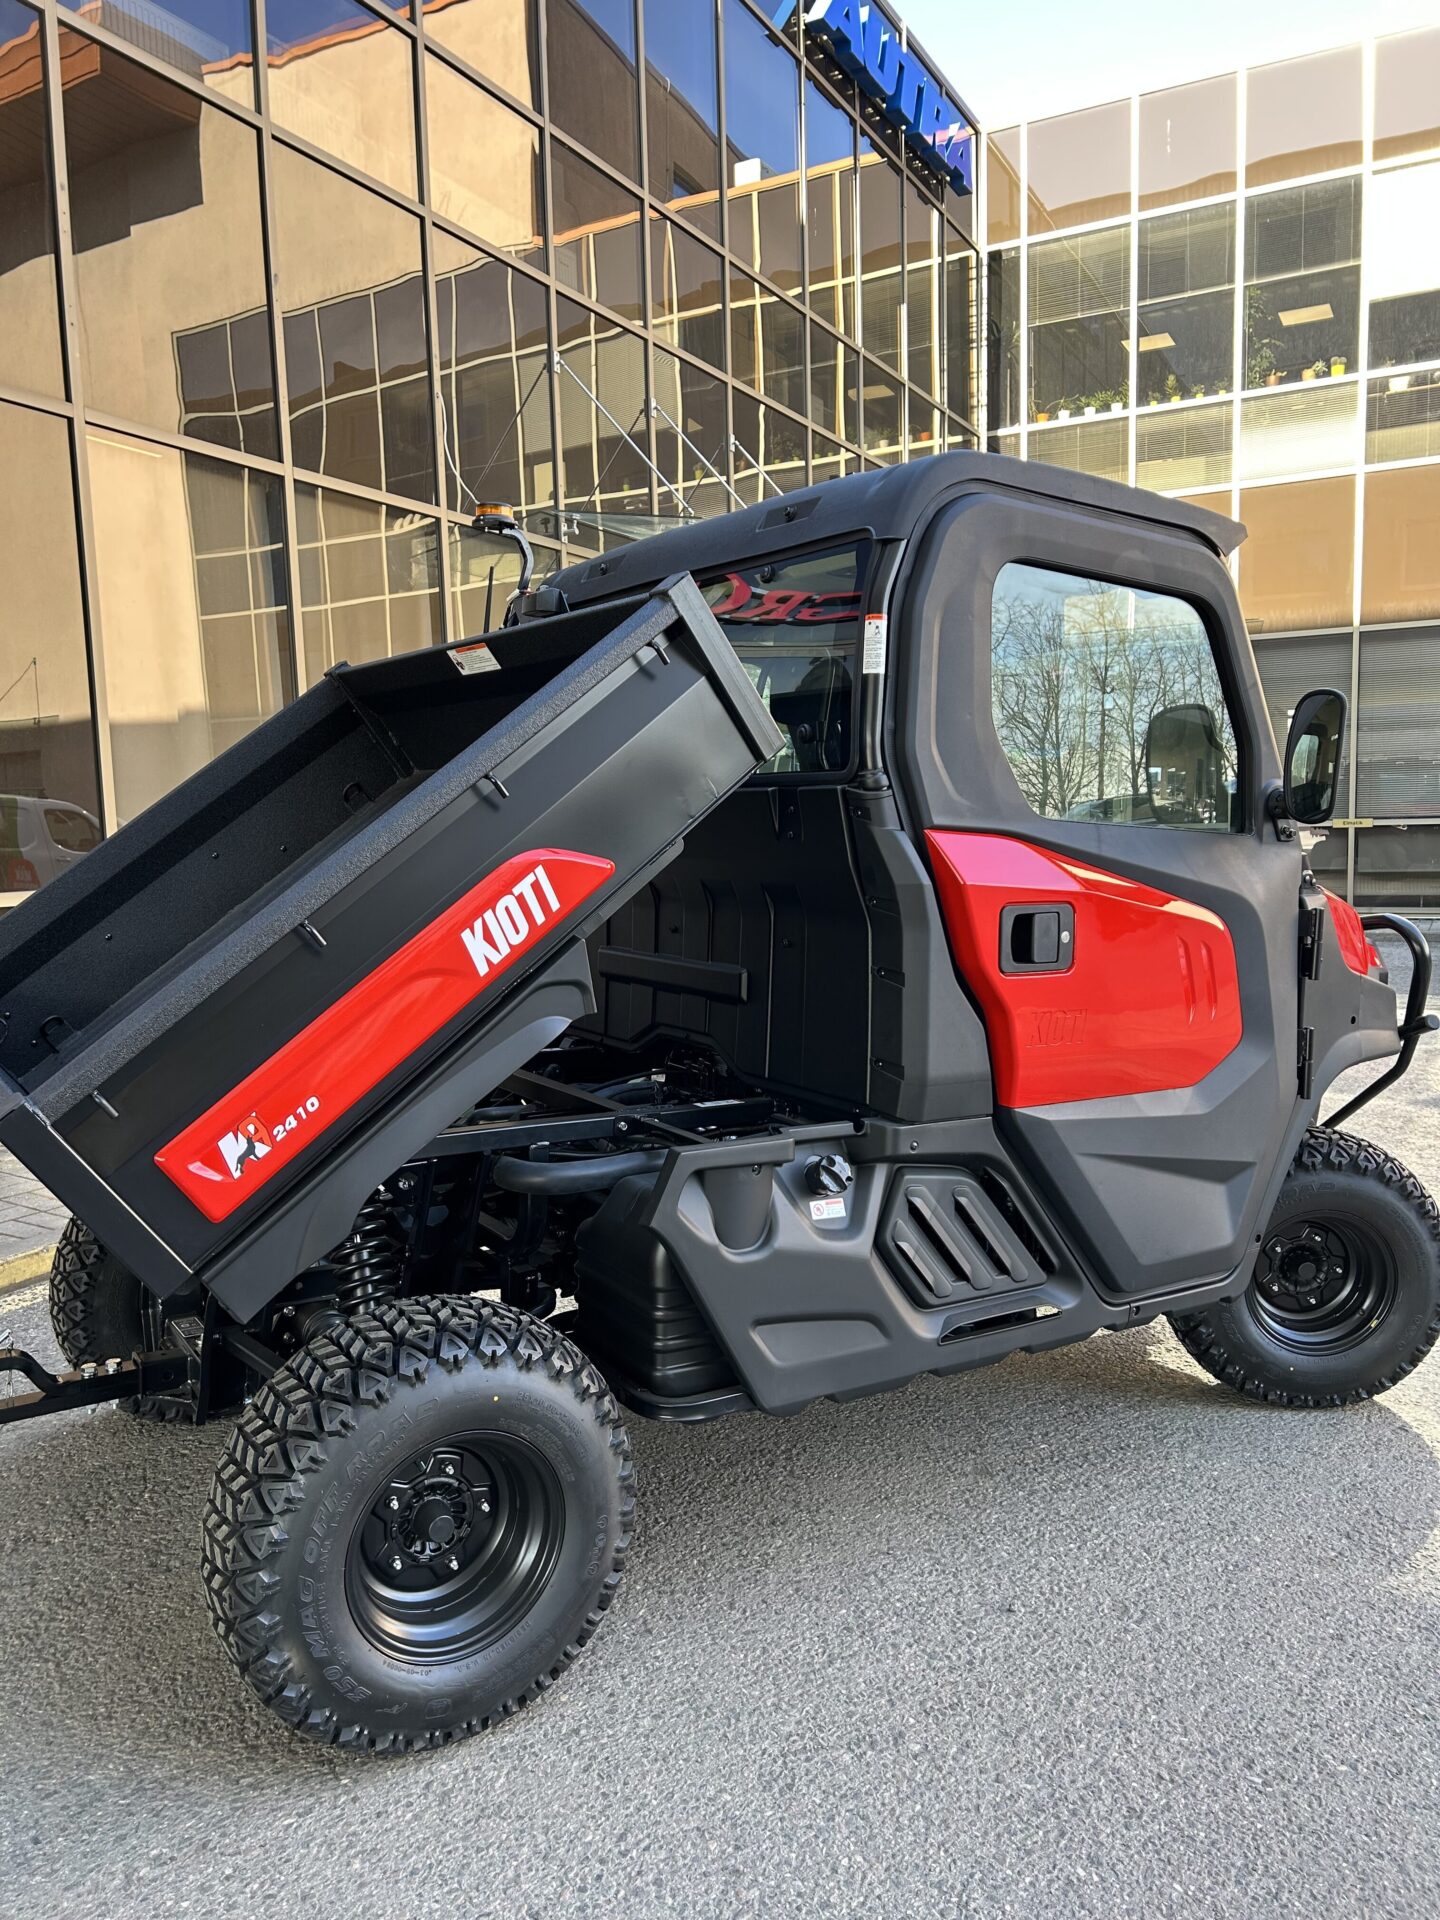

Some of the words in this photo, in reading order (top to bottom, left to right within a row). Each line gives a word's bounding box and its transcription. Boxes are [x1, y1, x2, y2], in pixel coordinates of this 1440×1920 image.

[460, 864, 561, 977] KIOTI
[272, 1095, 320, 1142] 2410
[346, 1396, 439, 1480] ROAD
[303, 1481, 338, 1563] OFF
[298, 1575, 331, 1658] MAG
[323, 1665, 372, 1703] 350
